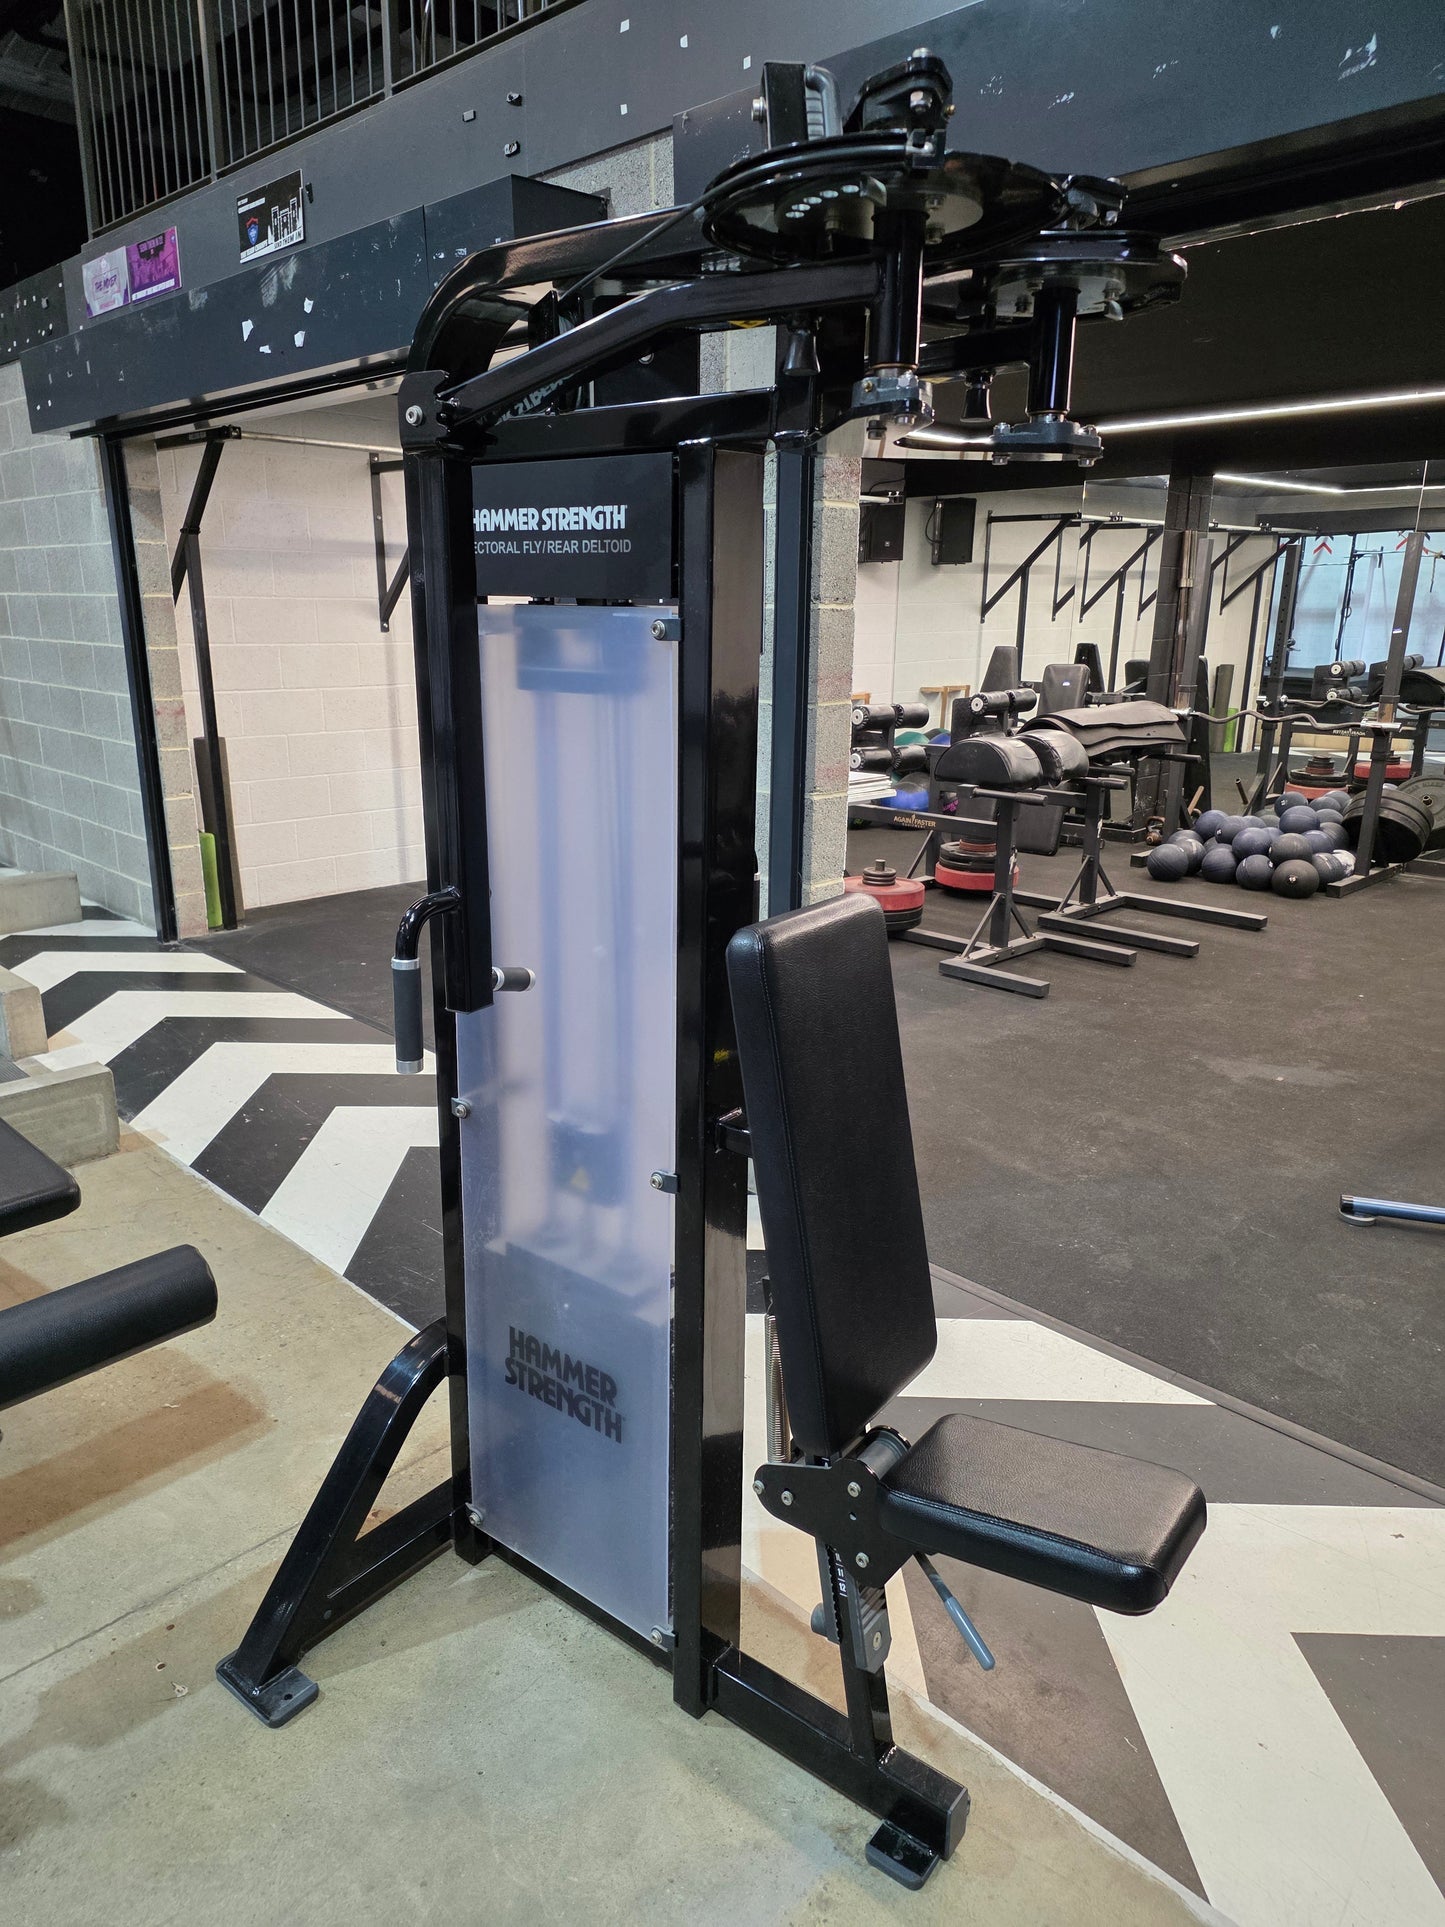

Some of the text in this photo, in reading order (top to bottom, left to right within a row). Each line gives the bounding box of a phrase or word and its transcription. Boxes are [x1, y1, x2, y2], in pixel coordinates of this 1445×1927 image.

[541, 505, 626, 531] STRENGTH
[474, 541, 521, 554] CTORAL
[582, 539, 632, 553] DELTOID
[894, 815, 912, 823] AGAIN
[914, 819, 936, 828] FASTER
[509, 1325, 618, 1408] HAMMER
[505, 1357, 622, 1444] STRENGTH
[837, 1568, 844, 1577] 11
[839, 1582, 846, 1592] 12
